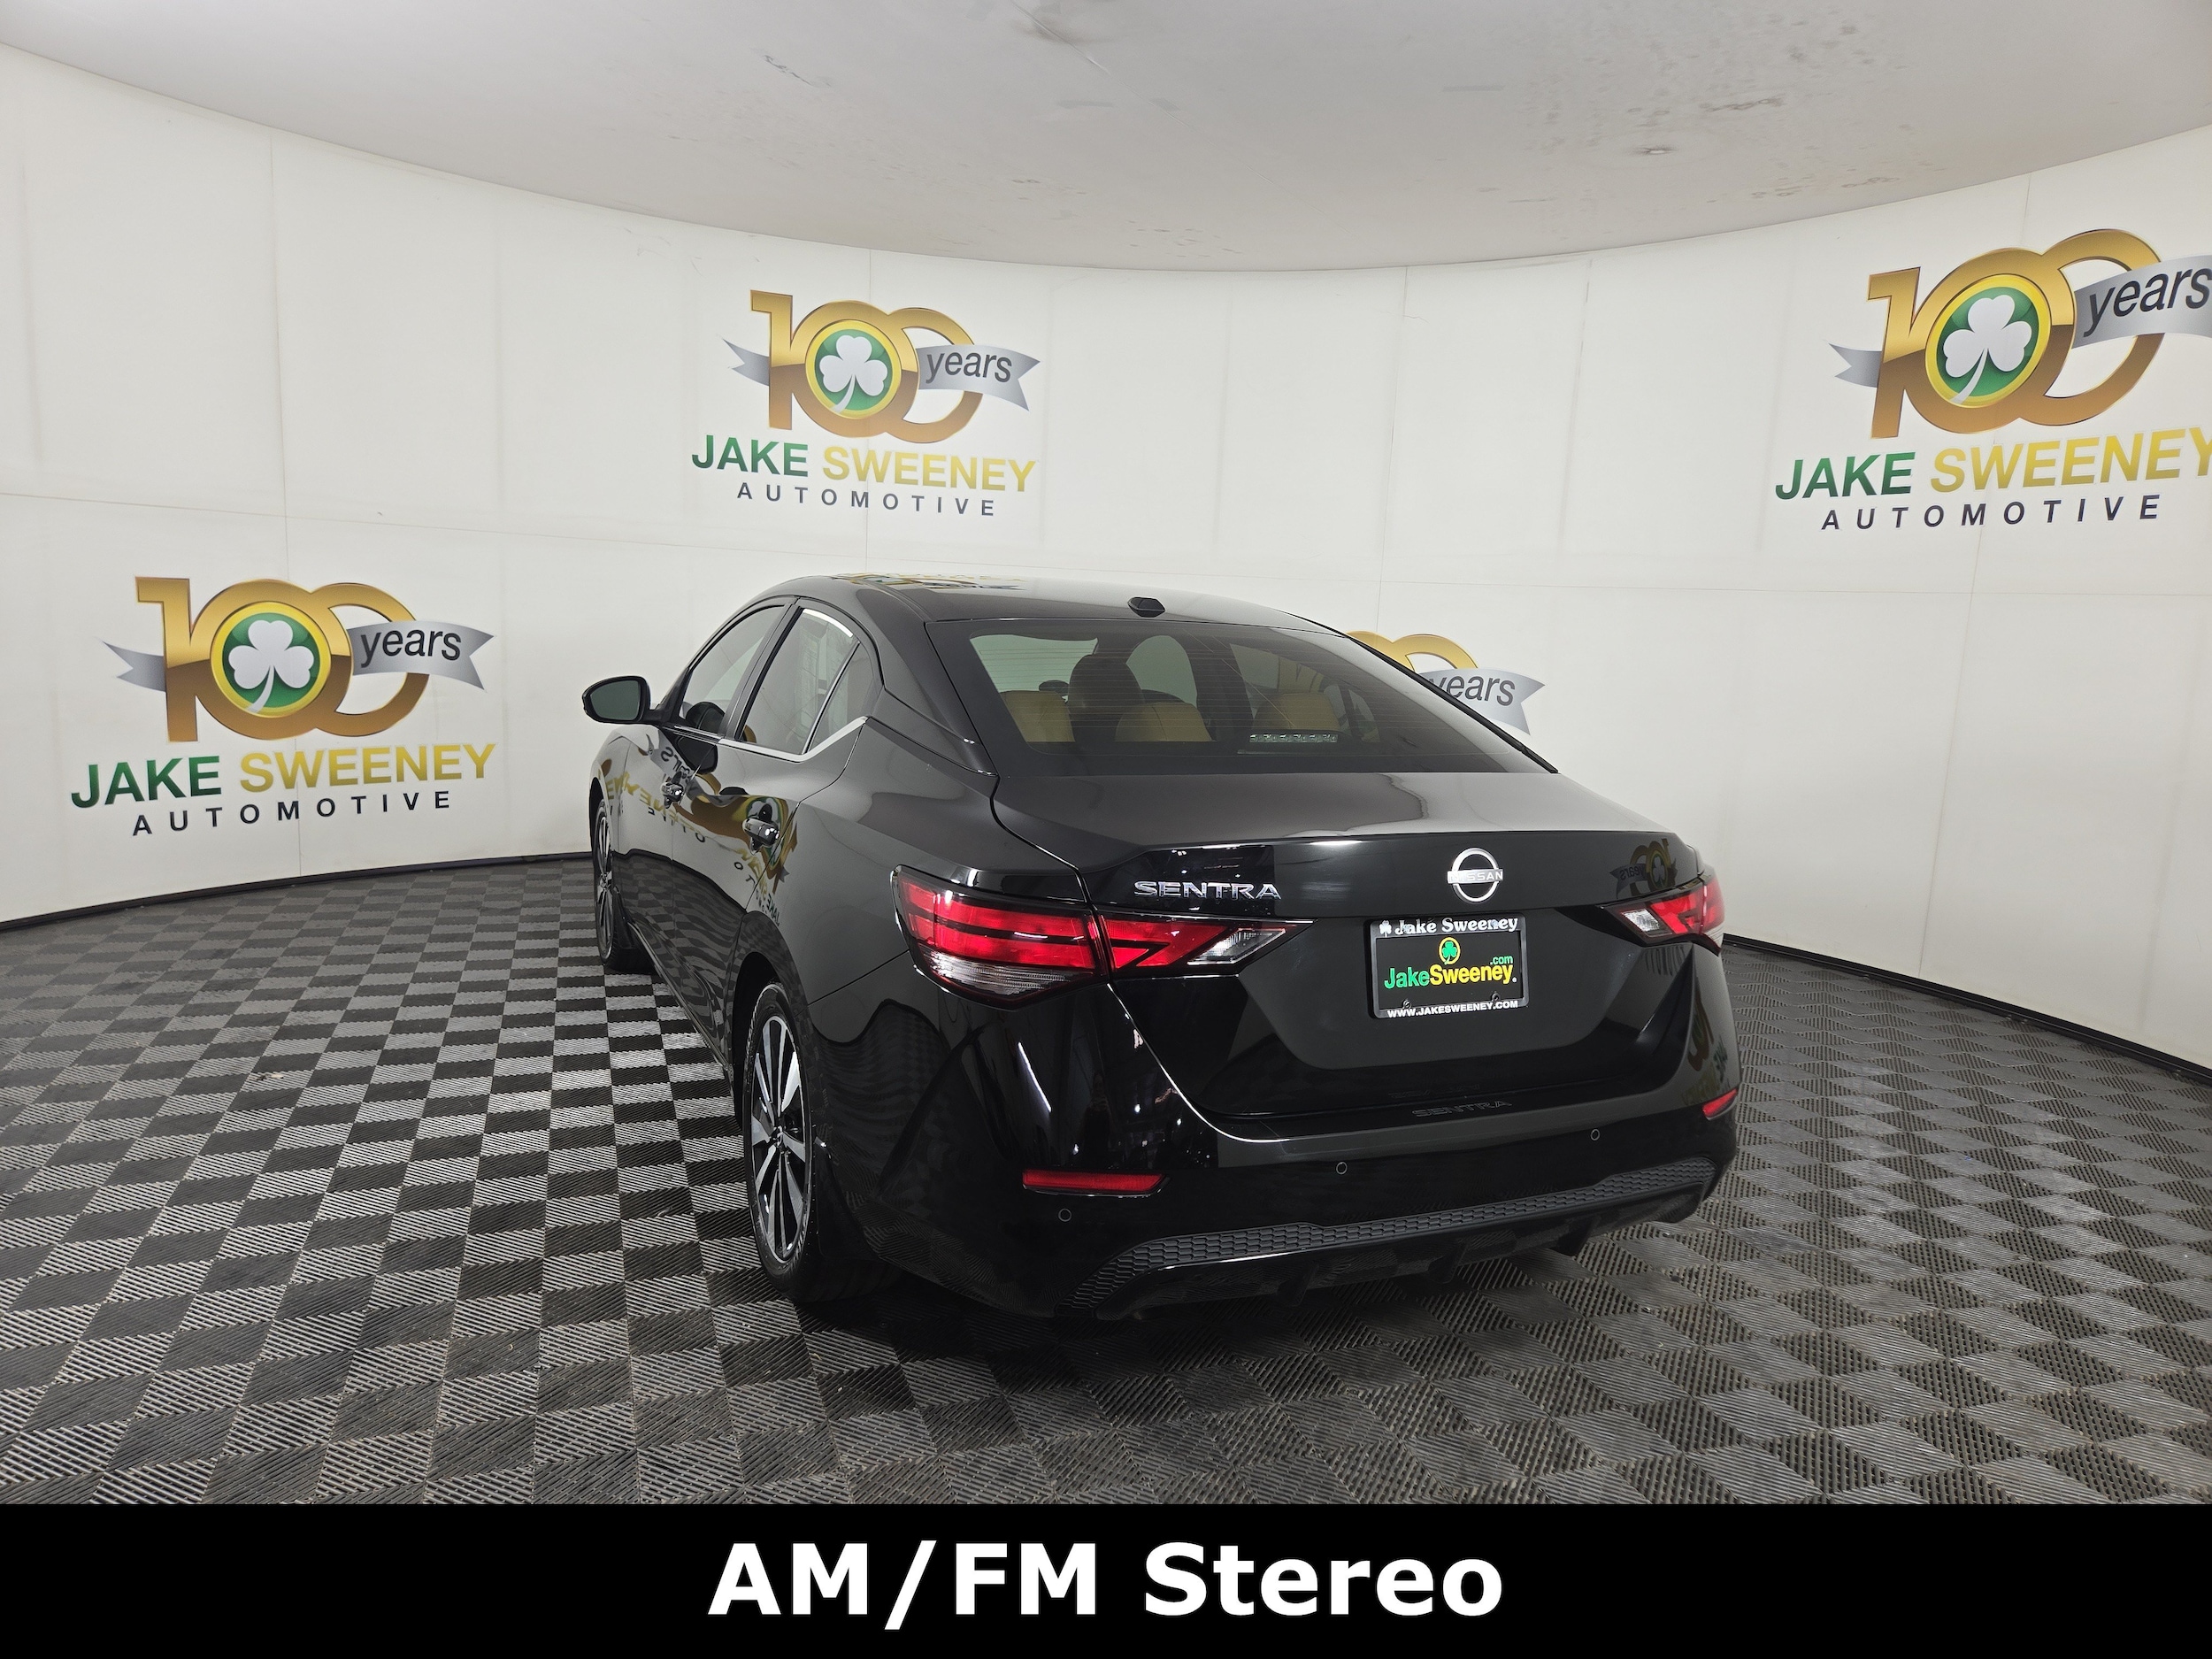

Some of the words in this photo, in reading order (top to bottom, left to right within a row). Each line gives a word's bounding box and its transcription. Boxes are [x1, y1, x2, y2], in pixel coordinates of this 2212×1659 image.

[1867, 228, 2164, 439] 100
[2083, 267, 2212, 338] years
[749, 289, 984, 443] 100
[925, 350, 1013, 383] years
[691, 434, 809, 477] JAKE
[823, 446, 1036, 492] SWEENEY
[1775, 451, 1916, 501] JAKE
[1930, 426, 2212, 493] SWEENEY
[737, 481, 995, 517] AUTOMOTIVE
[1821, 494, 2161, 531] AUTOMOTIVE
[135, 576, 429, 741] 100
[360, 625, 462, 667] years
[71, 755, 222, 809] JAKE
[240, 742, 496, 794] SWEENEY
[133, 790, 450, 836] AUTOMOTIVE
[1134, 881, 1282, 900] SENTRA
[1394, 919, 1437, 935] Jake
[1441, 918, 1518, 932] Sweeney
[1490, 956, 1513, 964] .com
[1388, 1001, 1518, 1018] WWW.JAKESWEENEY.COM
[1412, 1100, 1513, 1118] SENTRA
